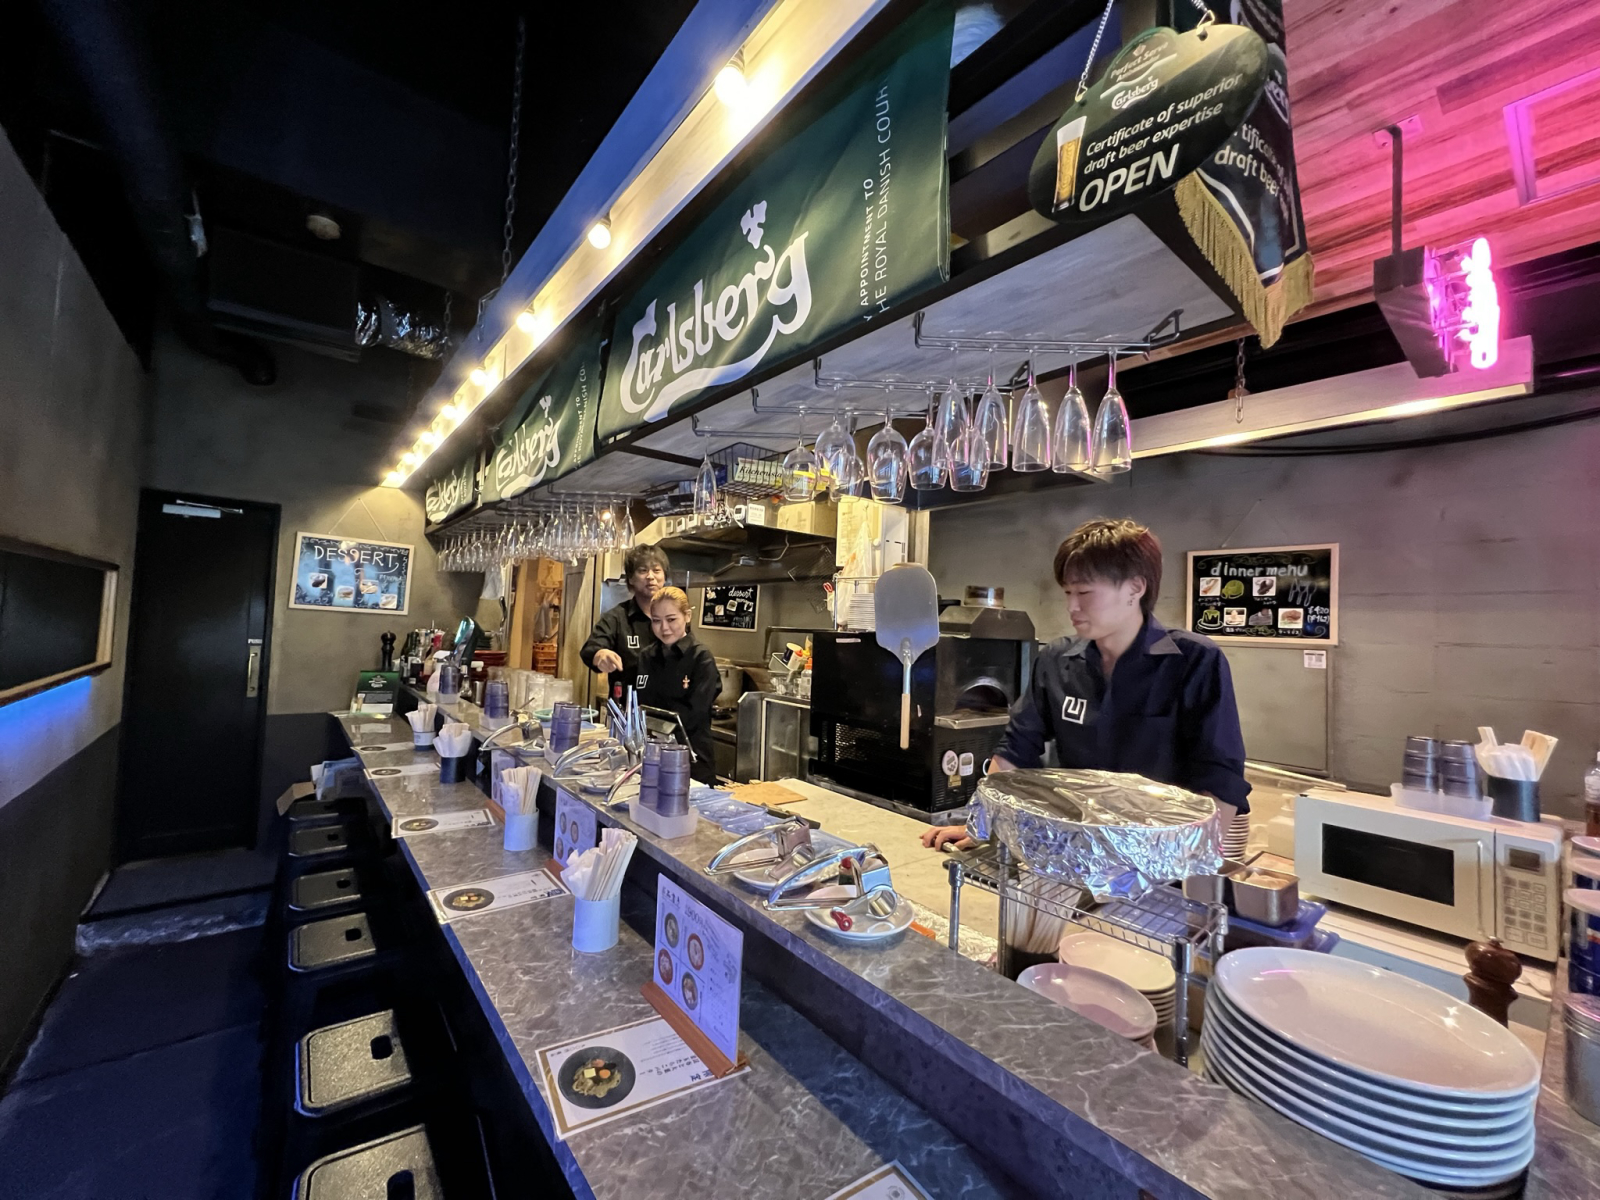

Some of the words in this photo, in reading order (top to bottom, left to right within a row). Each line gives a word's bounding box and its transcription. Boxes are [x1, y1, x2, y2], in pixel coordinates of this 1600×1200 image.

[1086, 116, 1153, 156] Certificate
[1157, 103, 1174, 123] of
[1176, 73, 1243, 114] superior
[1112, 78, 1159, 110] Carlsberg
[1083, 151, 1116, 174] draft
[1119, 136, 1150, 158] beer
[1153, 102, 1223, 143] expertise
[863, 178, 874, 202] TO
[877, 148, 892, 215] DANISH
[1079, 143, 1180, 212] OPEN
[1214, 145, 1258, 177] draft
[1259, 164, 1280, 197] beer
[859, 205, 874, 306] APPOINTMENT
[875, 220, 890, 276] ROYAL
[620, 232, 813, 417] Carlsberg
[875, 285, 890, 314] HE
[314, 545, 398, 568] DESSERT
[1210, 562, 1261, 577] dinner
[1266, 564, 1308, 577] menu
